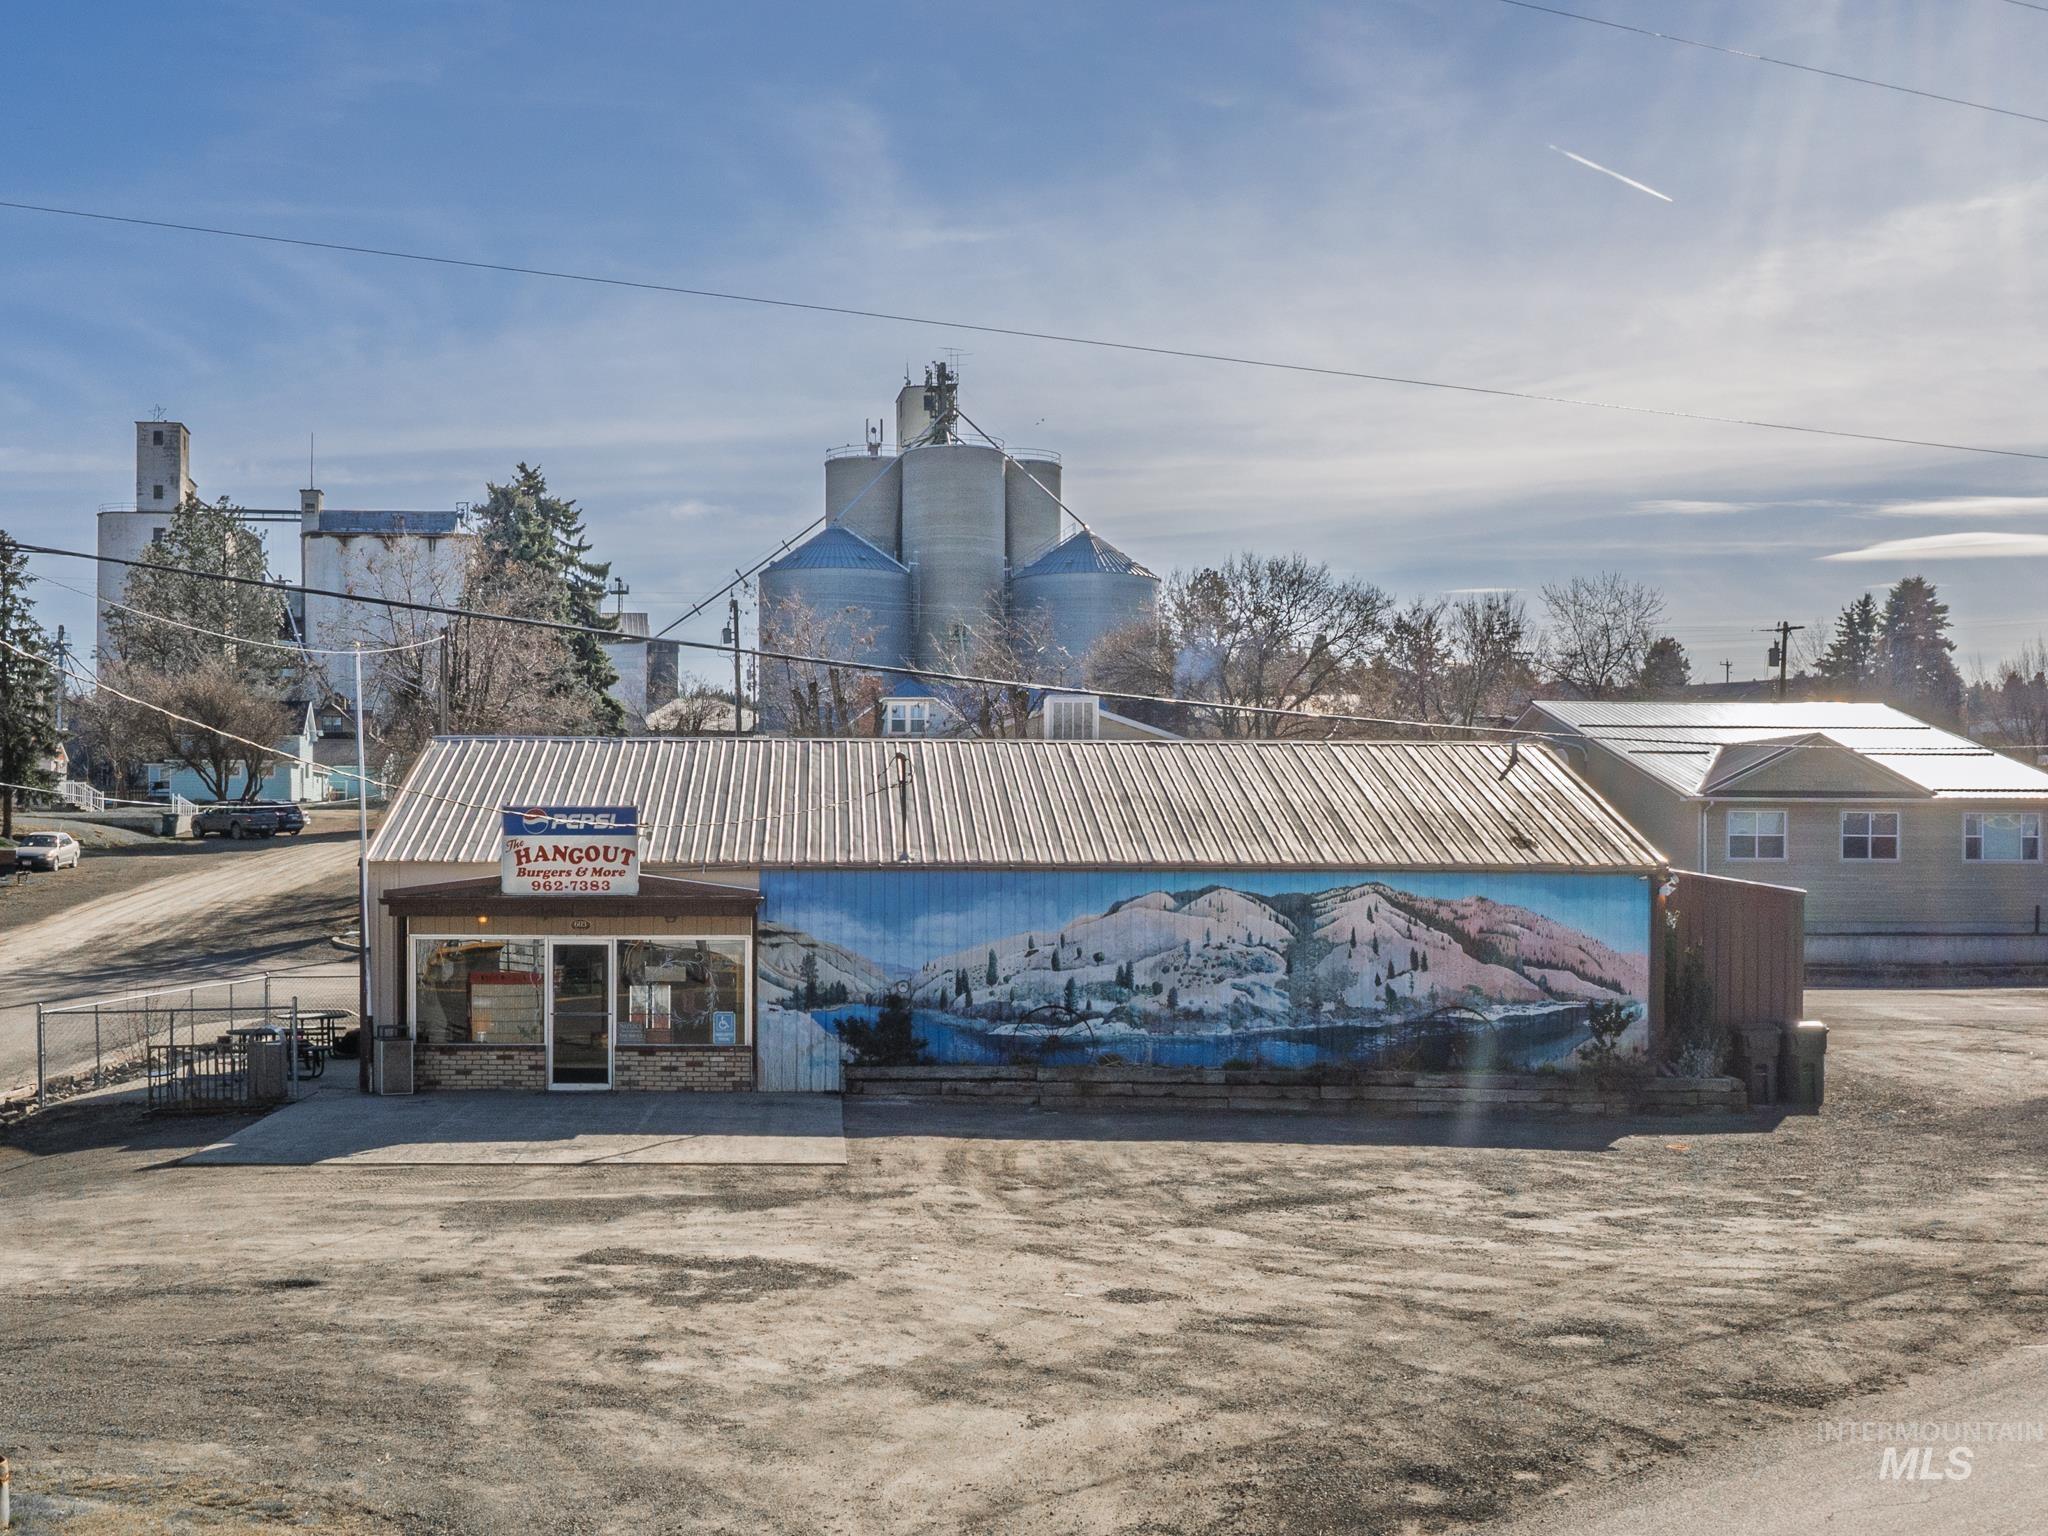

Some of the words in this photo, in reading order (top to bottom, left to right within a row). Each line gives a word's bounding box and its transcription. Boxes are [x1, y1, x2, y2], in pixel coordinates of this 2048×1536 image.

[551, 813, 616, 830] PEPSI
[506, 839, 524, 853] The
[515, 845, 636, 866] HANGOUT
[517, 867, 572, 879] Burgers
[575, 867, 588, 877] &
[590, 867, 626, 877] More
[532, 881, 610, 892] 962-7383
